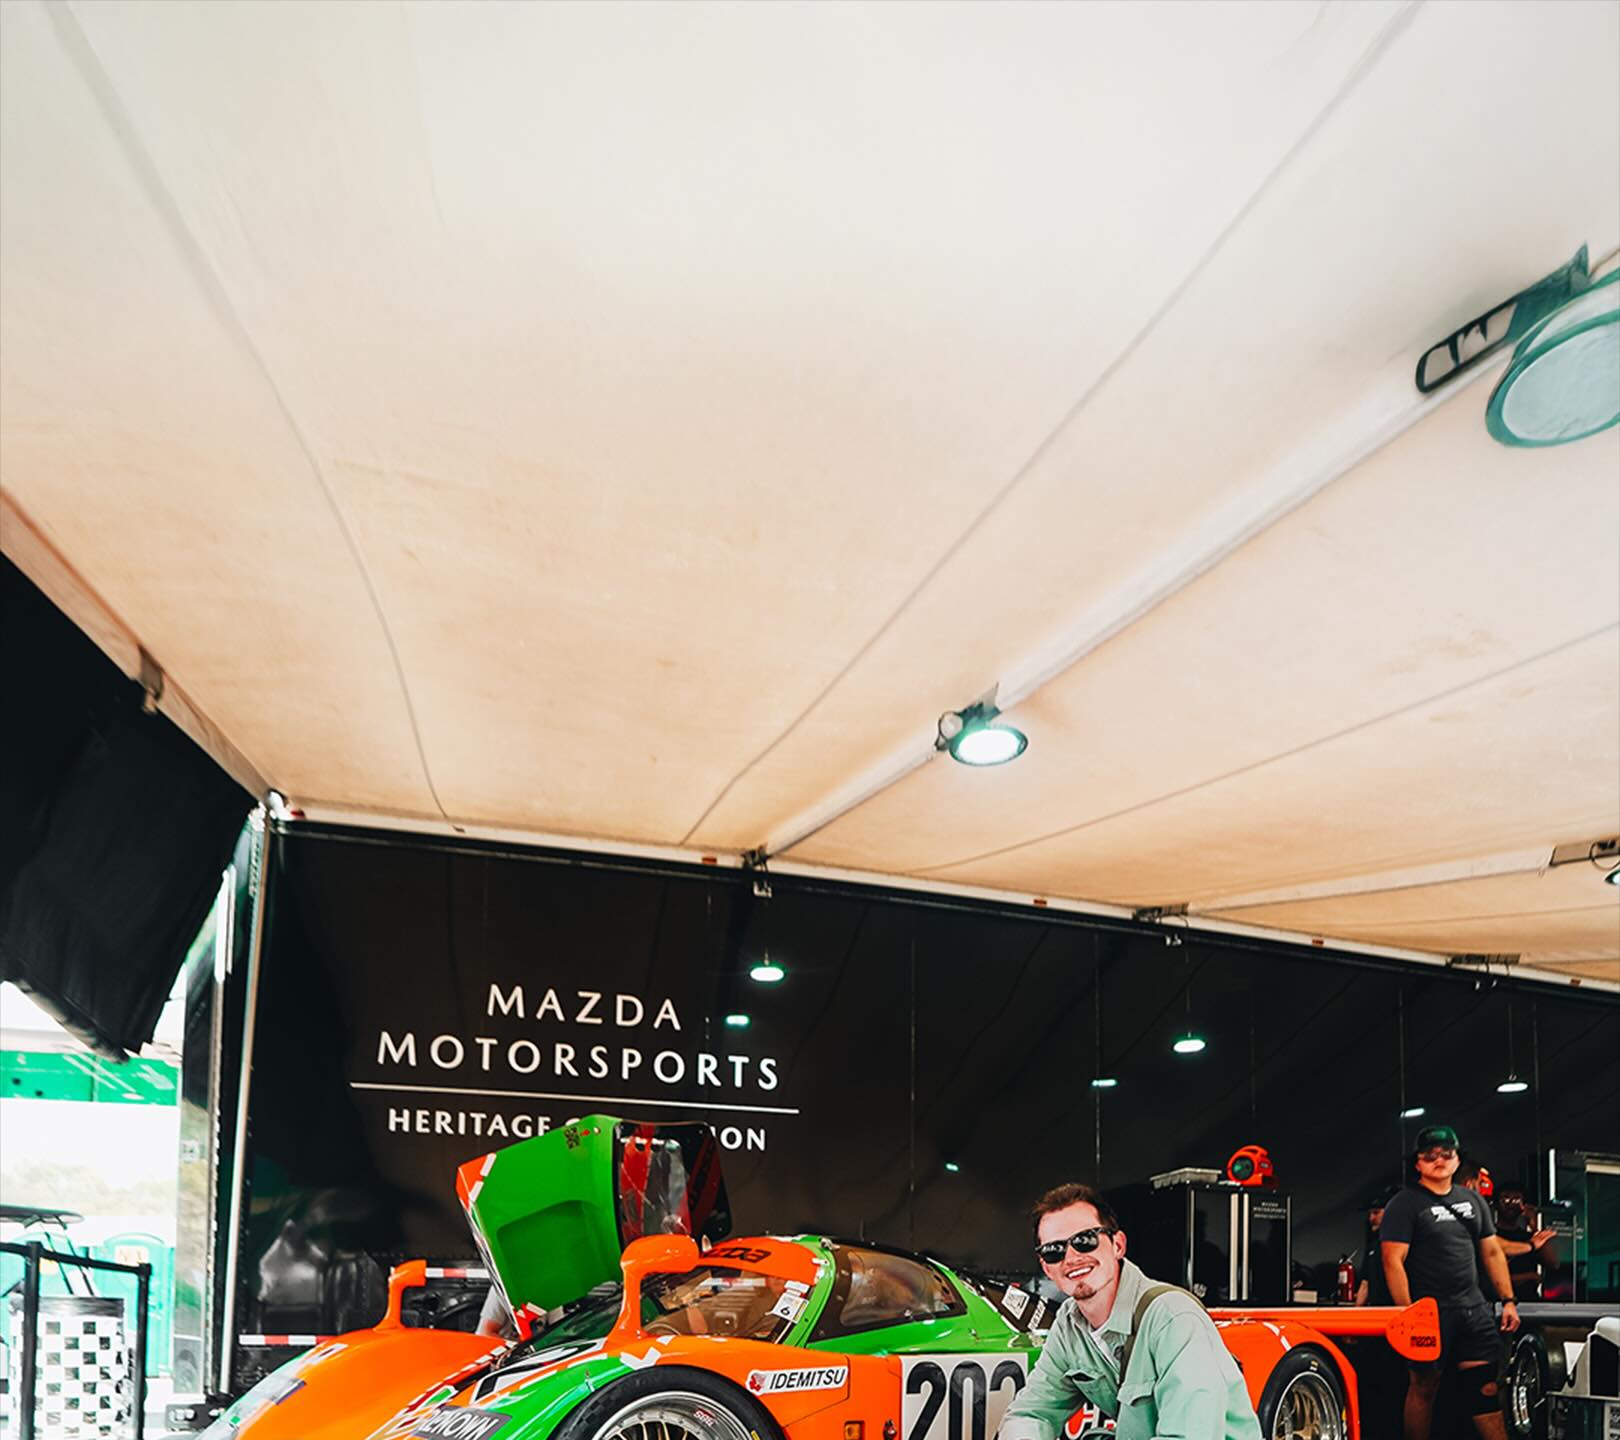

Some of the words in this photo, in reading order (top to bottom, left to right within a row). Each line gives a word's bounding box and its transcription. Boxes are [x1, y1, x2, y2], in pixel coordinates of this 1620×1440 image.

[486, 983, 682, 1031] MAZDA
[376, 1031, 779, 1091] MOTORSPORTS
[387, 1108, 552, 1139] HERITAGE
[769, 1368, 846, 1389] IDEMITSU
